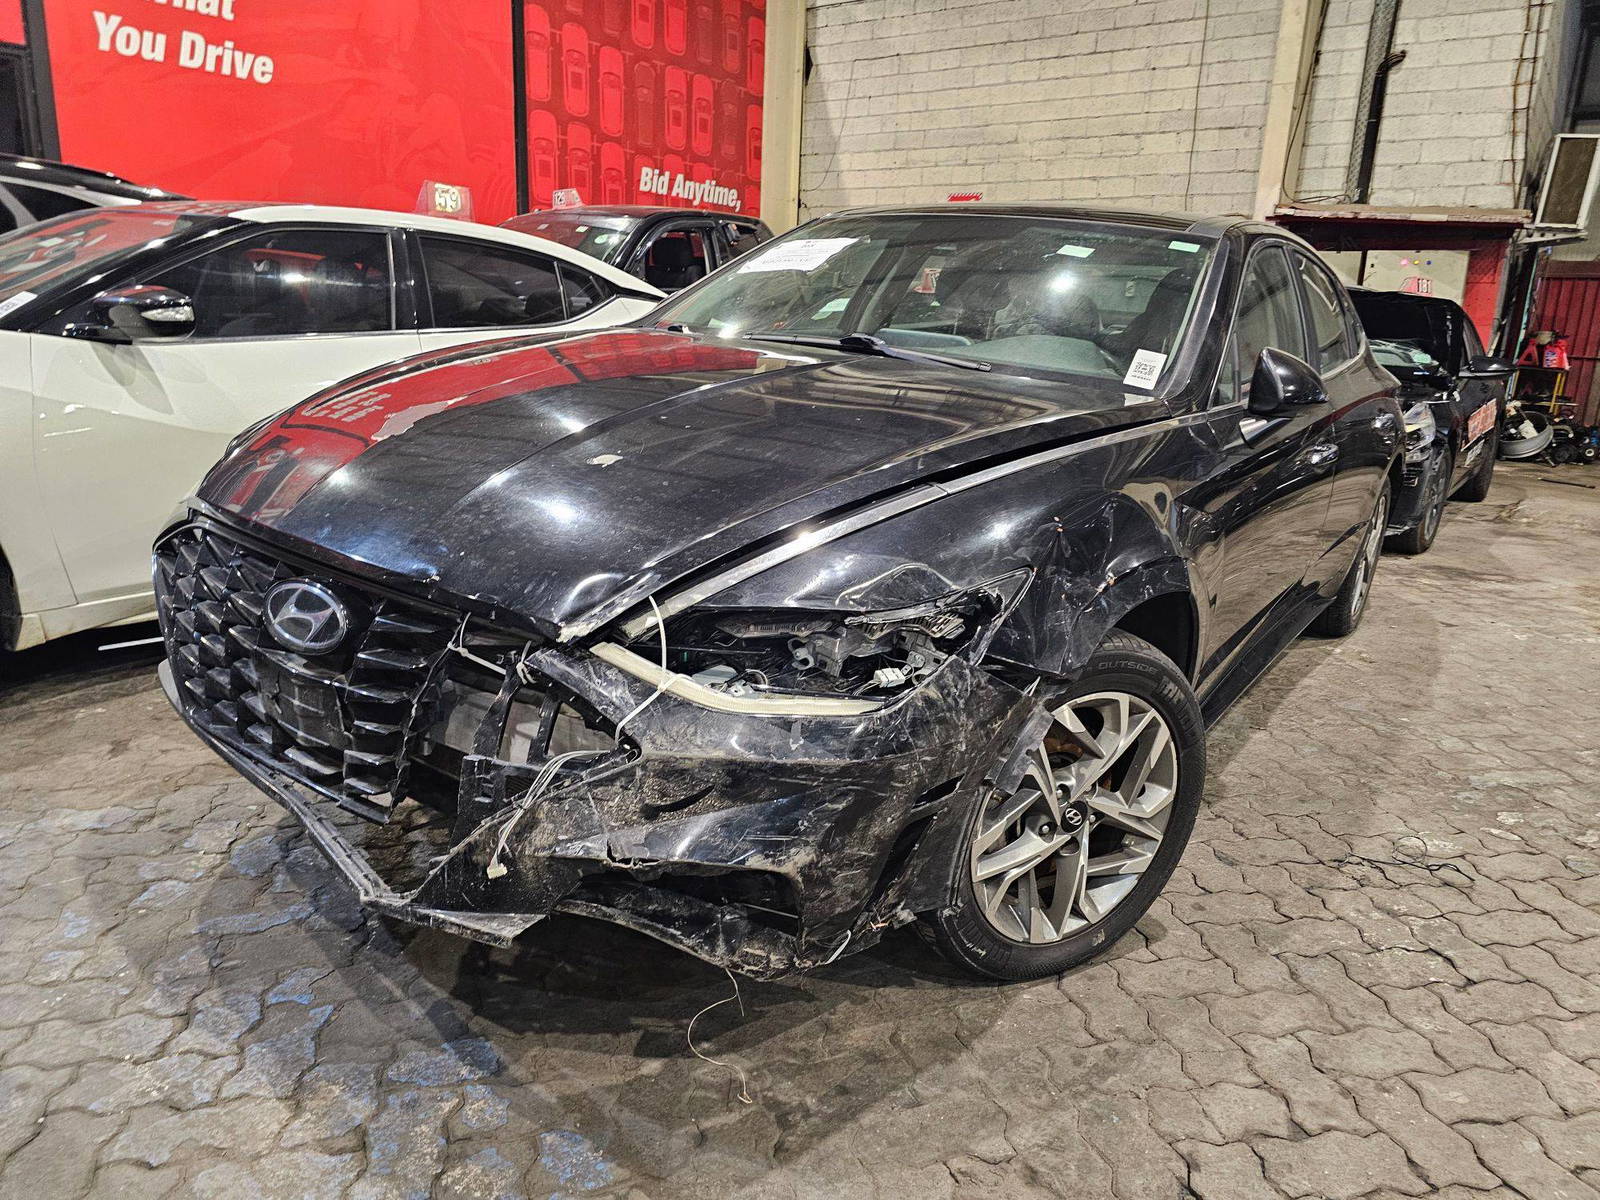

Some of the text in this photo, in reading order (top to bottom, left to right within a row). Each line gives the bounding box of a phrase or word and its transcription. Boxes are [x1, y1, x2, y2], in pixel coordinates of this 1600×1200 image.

[92, 10, 274, 84] You Drive
[640, 166, 741, 212] Bid Anytime,
